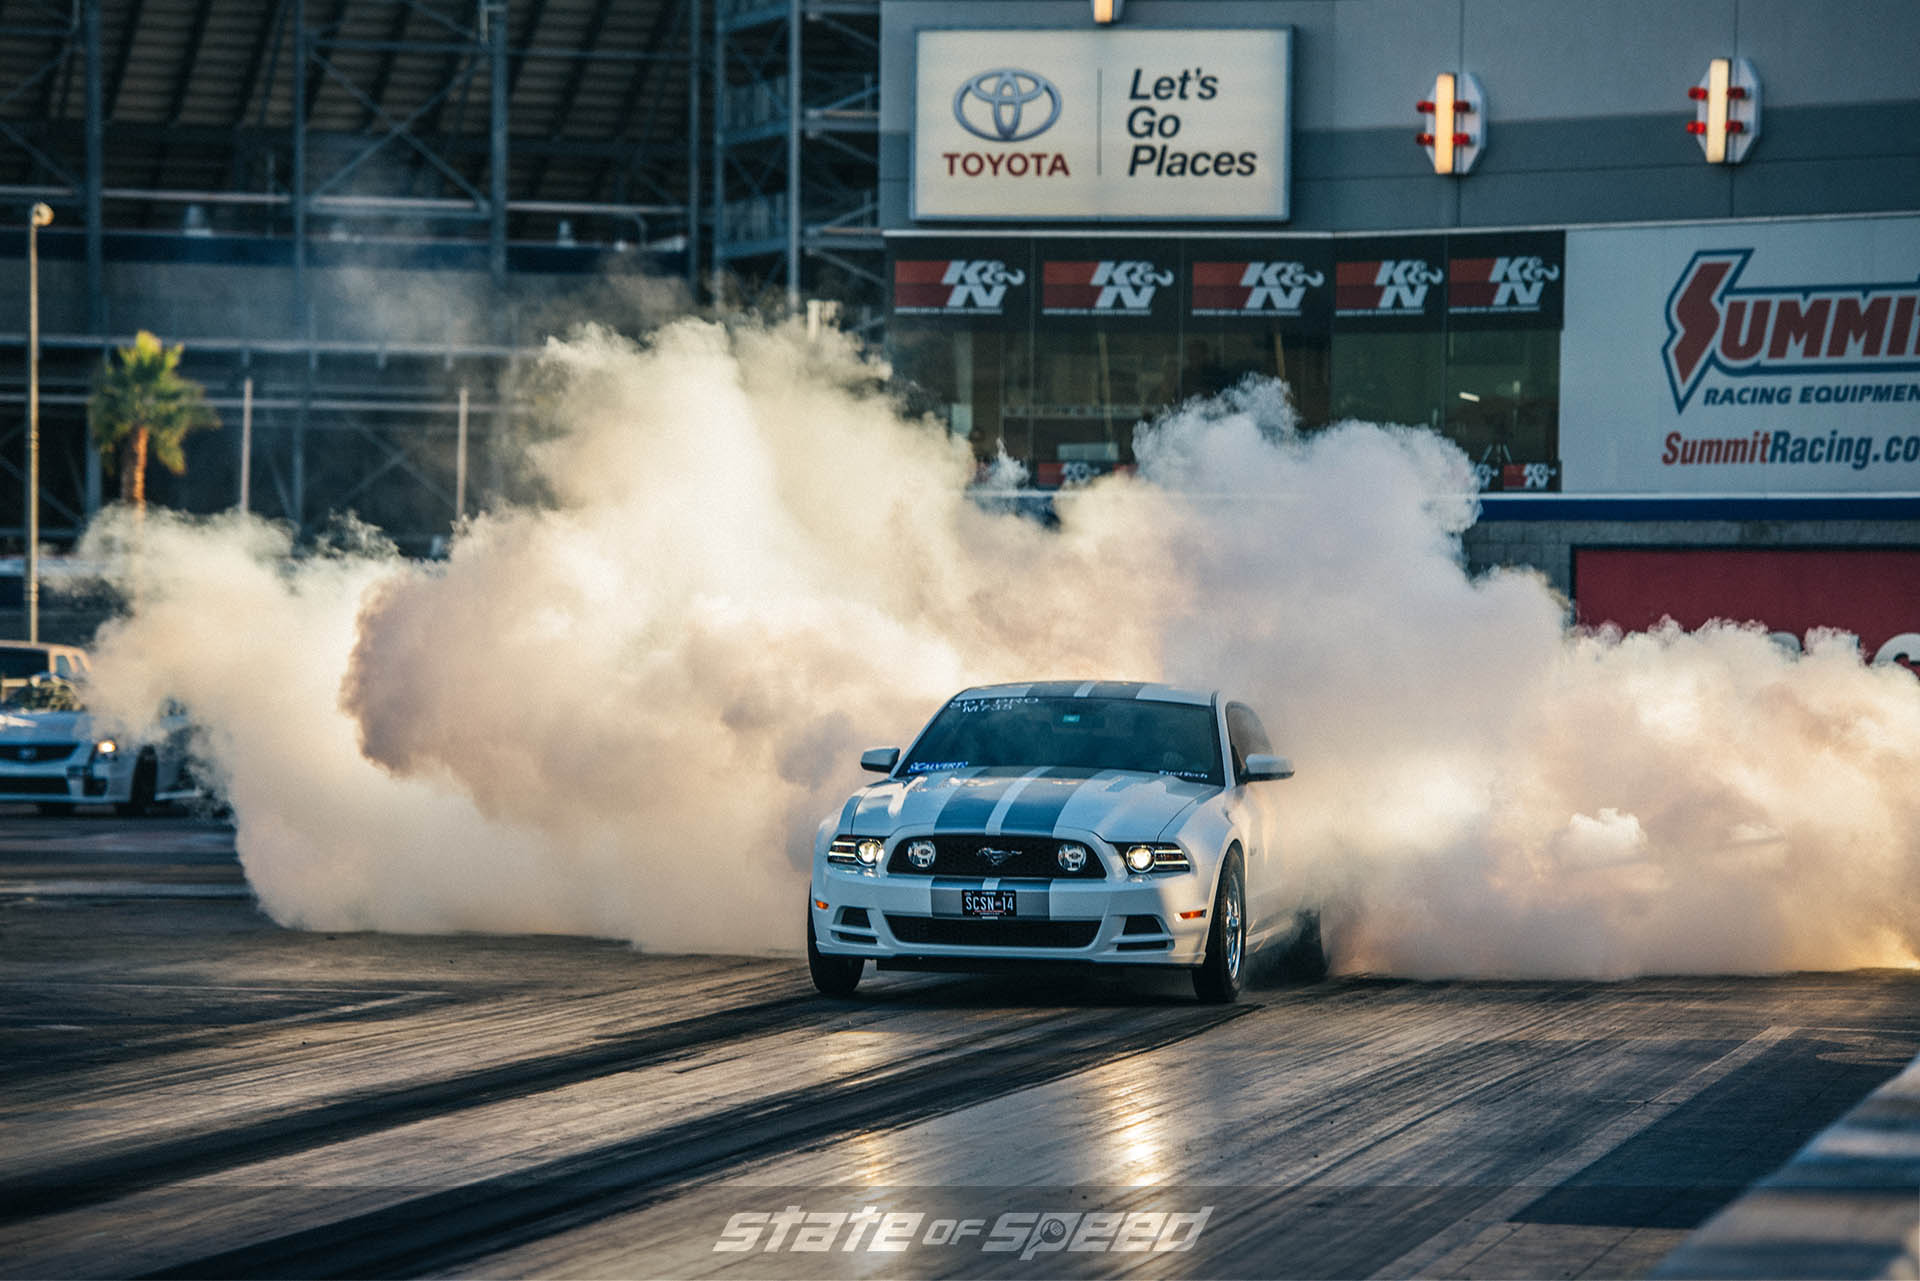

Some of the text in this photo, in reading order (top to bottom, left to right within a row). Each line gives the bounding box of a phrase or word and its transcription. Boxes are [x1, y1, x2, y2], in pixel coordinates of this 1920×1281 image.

[1128, 69, 1218, 101] Let's
[1127, 106, 1181, 138] Go
[942, 152, 1070, 177] TOYOTA
[1128, 144, 1257, 177] Places
[941, 259, 1025, 308] K&N
[1089, 260, 1174, 309] K&N
[1239, 261, 1324, 310] K&N
[1374, 259, 1444, 308] K&N
[1488, 256, 1559, 306] K&N
[1703, 387, 1792, 406] RACING
